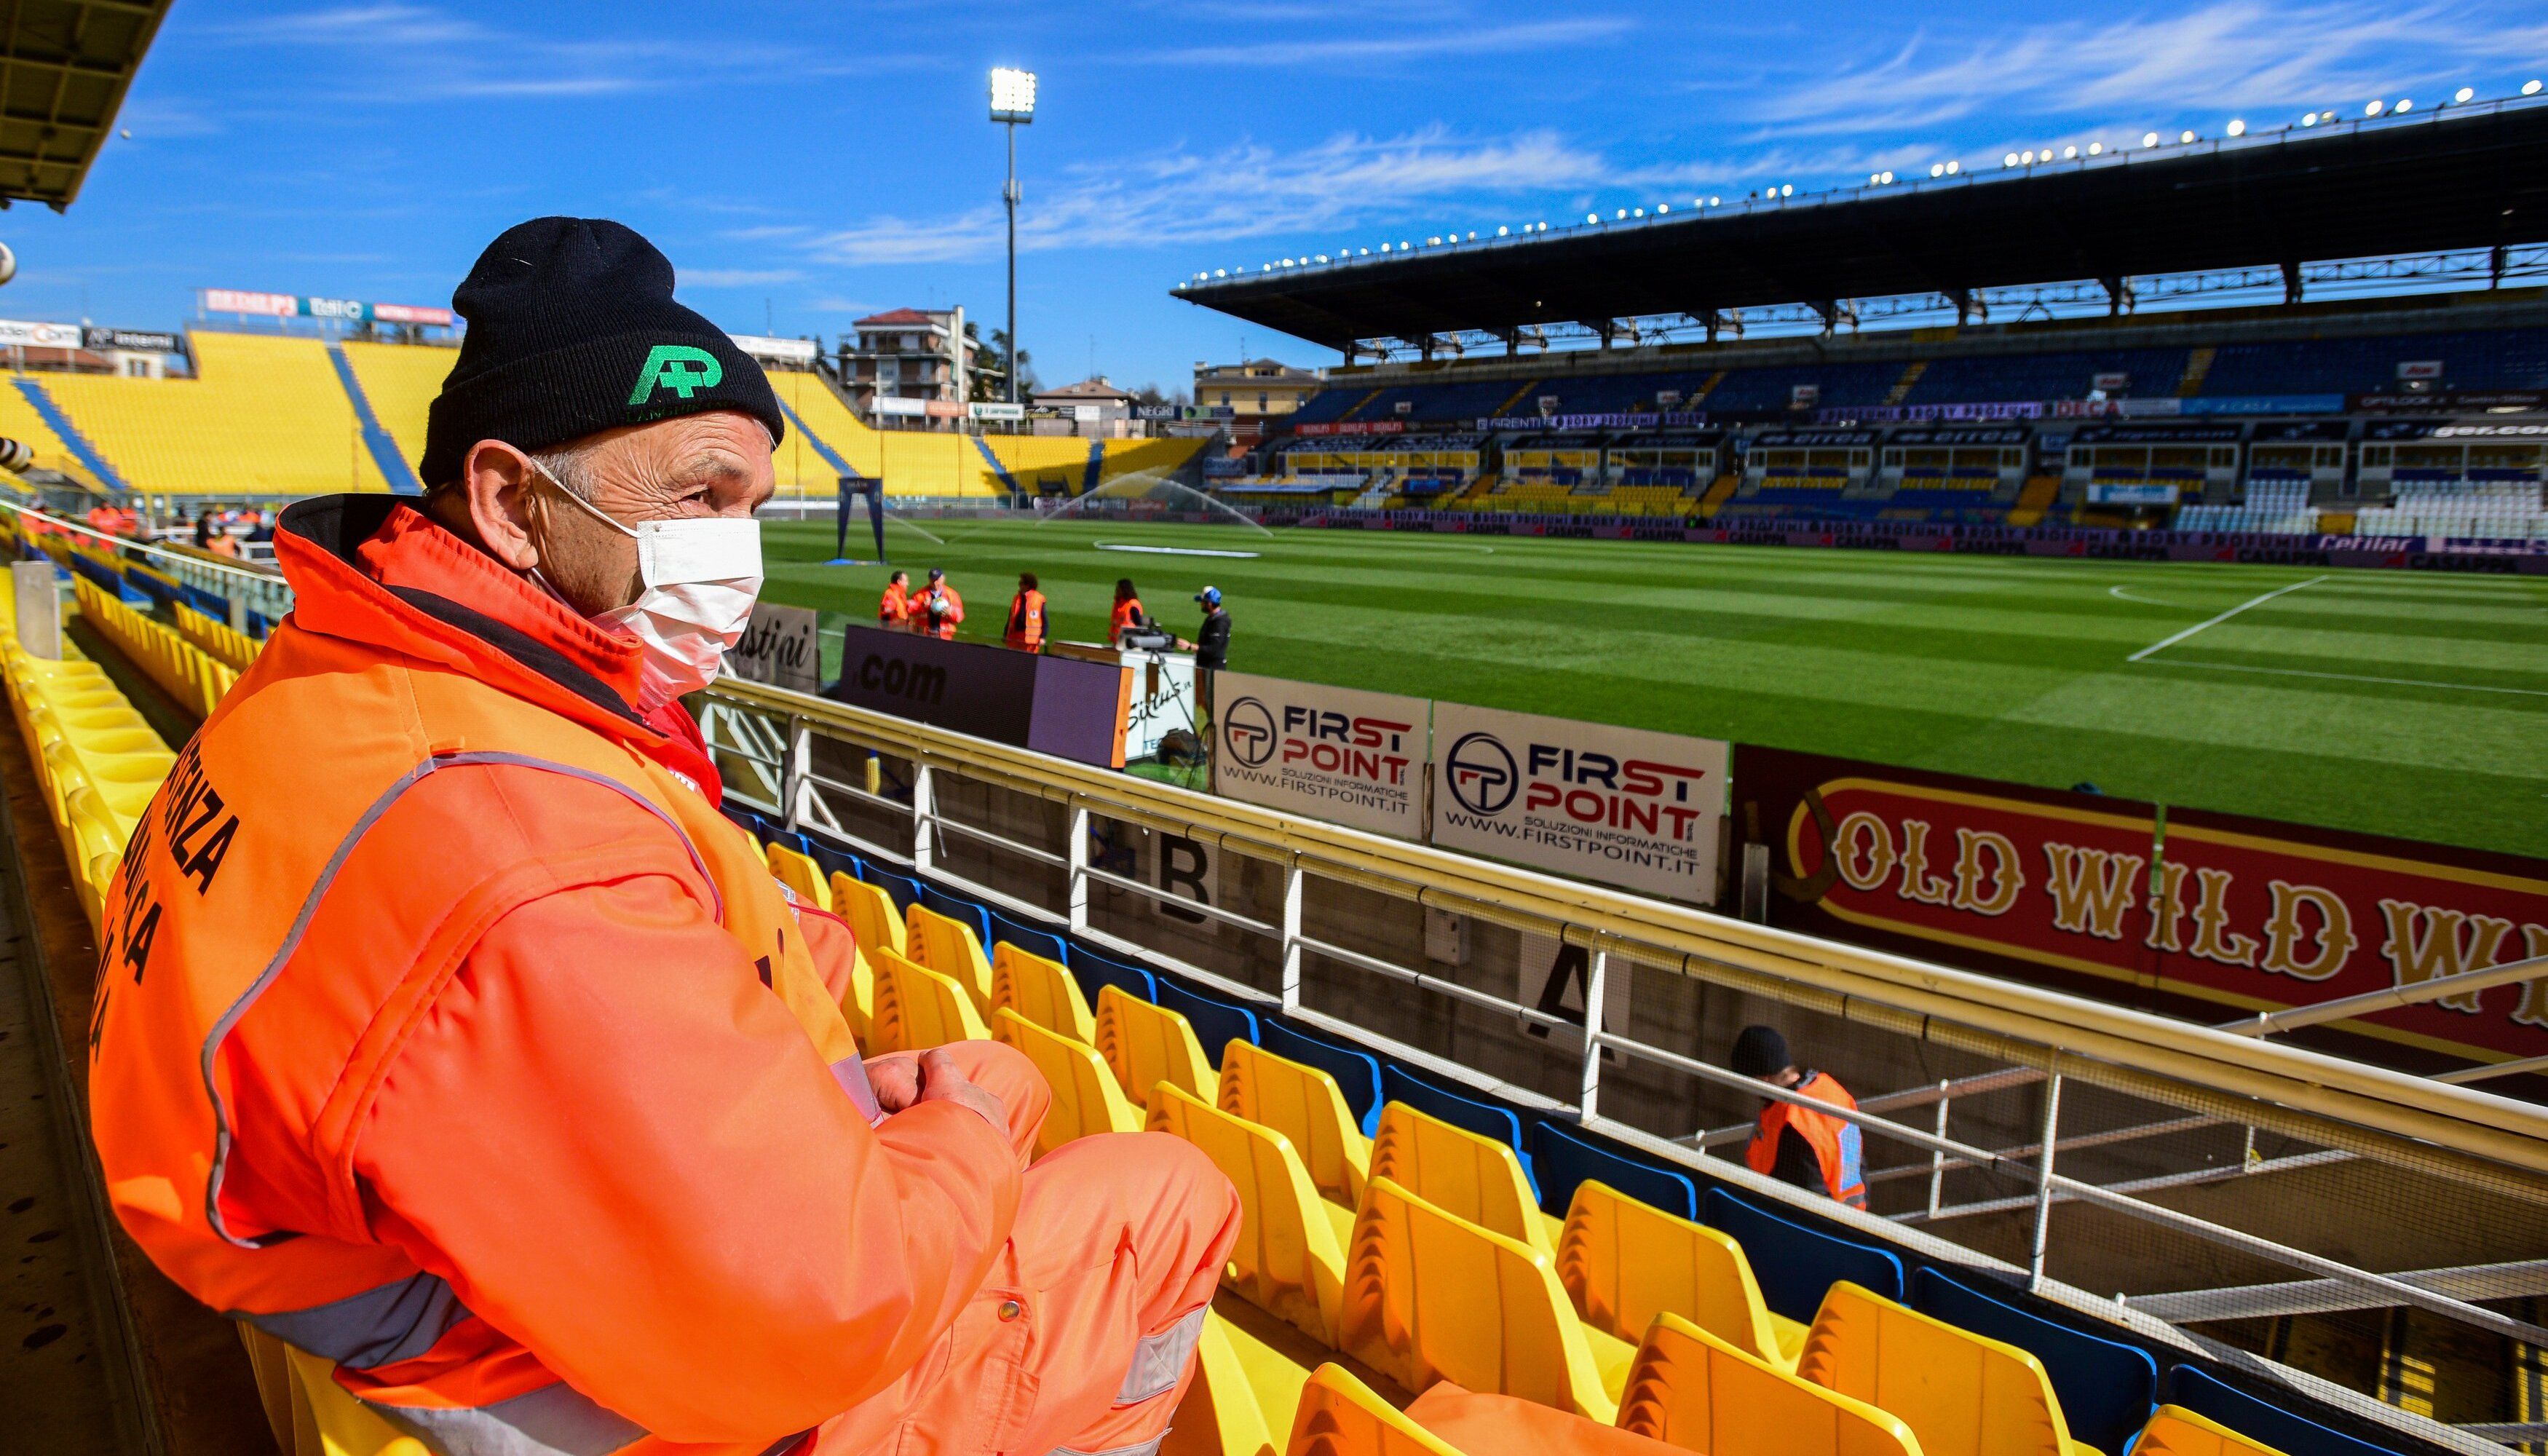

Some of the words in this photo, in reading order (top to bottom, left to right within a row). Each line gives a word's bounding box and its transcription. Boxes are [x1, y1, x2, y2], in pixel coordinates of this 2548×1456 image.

[1136, 405, 1174, 417] NEGRI
[860, 653, 946, 705] com
[1283, 705, 1412, 752] FIRST
[1281, 767, 1332, 785] SOLUZIONI
[1334, 779, 1409, 800] INFORMATICHE
[1283, 738, 1410, 785] POINT
[1529, 743, 1706, 802] FIRST
[1223, 765, 1410, 815] WWW.FIRSTPOINT.IT
[1527, 781, 1701, 841] POINT
[1445, 812, 1701, 876] WWW.FIRSTPOINT.IT
[1524, 816, 1593, 838] SOLUZIONI
[1596, 831, 1698, 860] INFORMATICHE
[1160, 831, 1209, 924] B
[1832, 811, 2026, 917] OLD
[2043, 842, 2358, 982] WILD
[1528, 943, 1615, 1061] A
